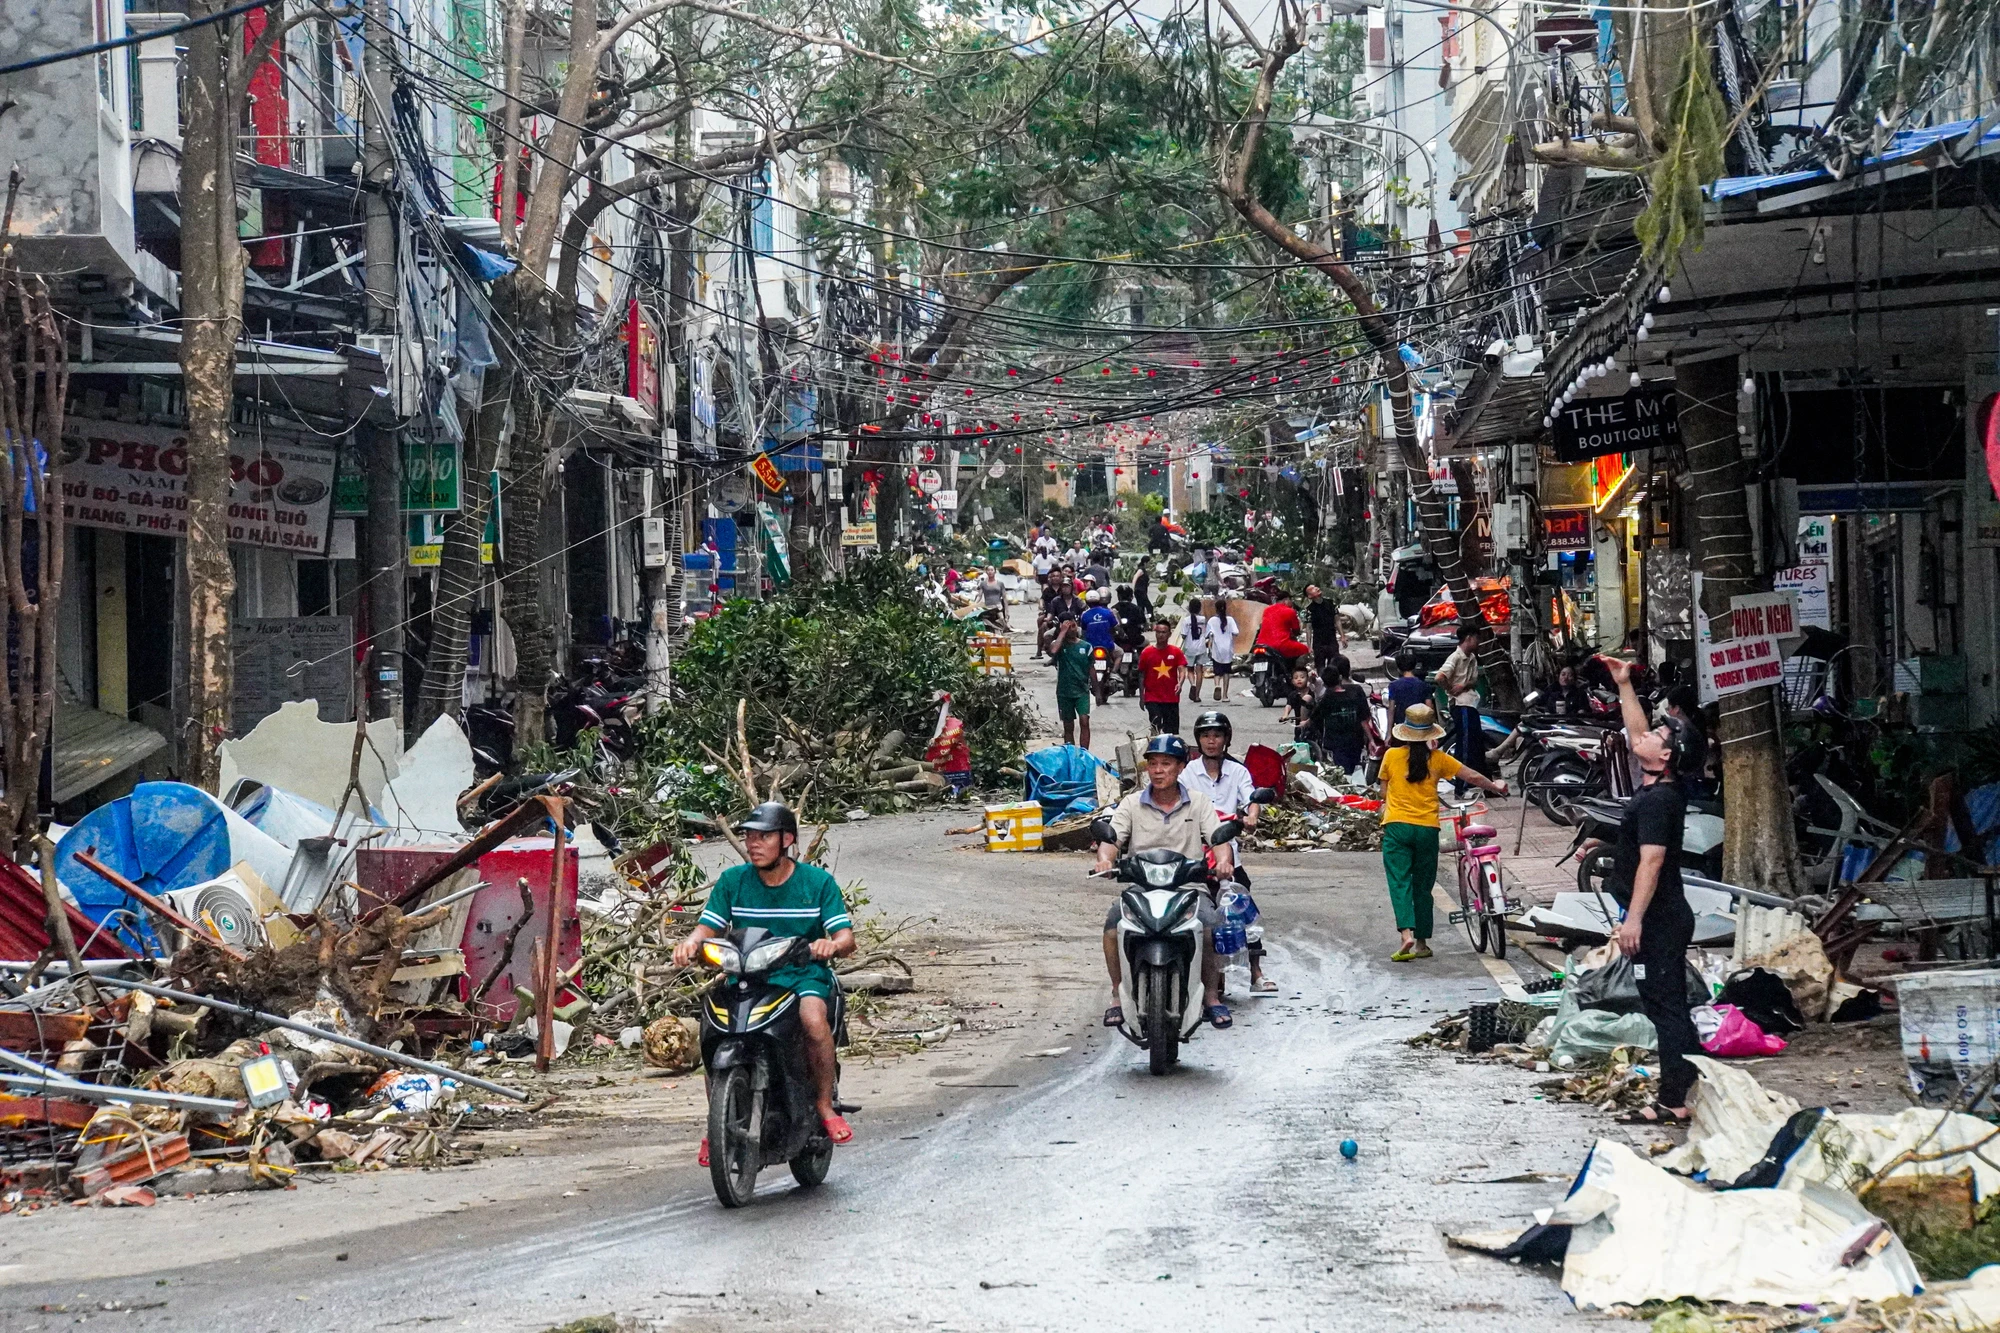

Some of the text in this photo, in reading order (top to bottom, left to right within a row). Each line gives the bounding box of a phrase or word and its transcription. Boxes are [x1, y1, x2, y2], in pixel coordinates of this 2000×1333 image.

[1565, 401, 1626, 429] THE
[1578, 425, 1660, 449] BOUTIQUE
[1732, 604, 1764, 637] HÒNG
[1957, 1005, 1968, 1029] ISO
